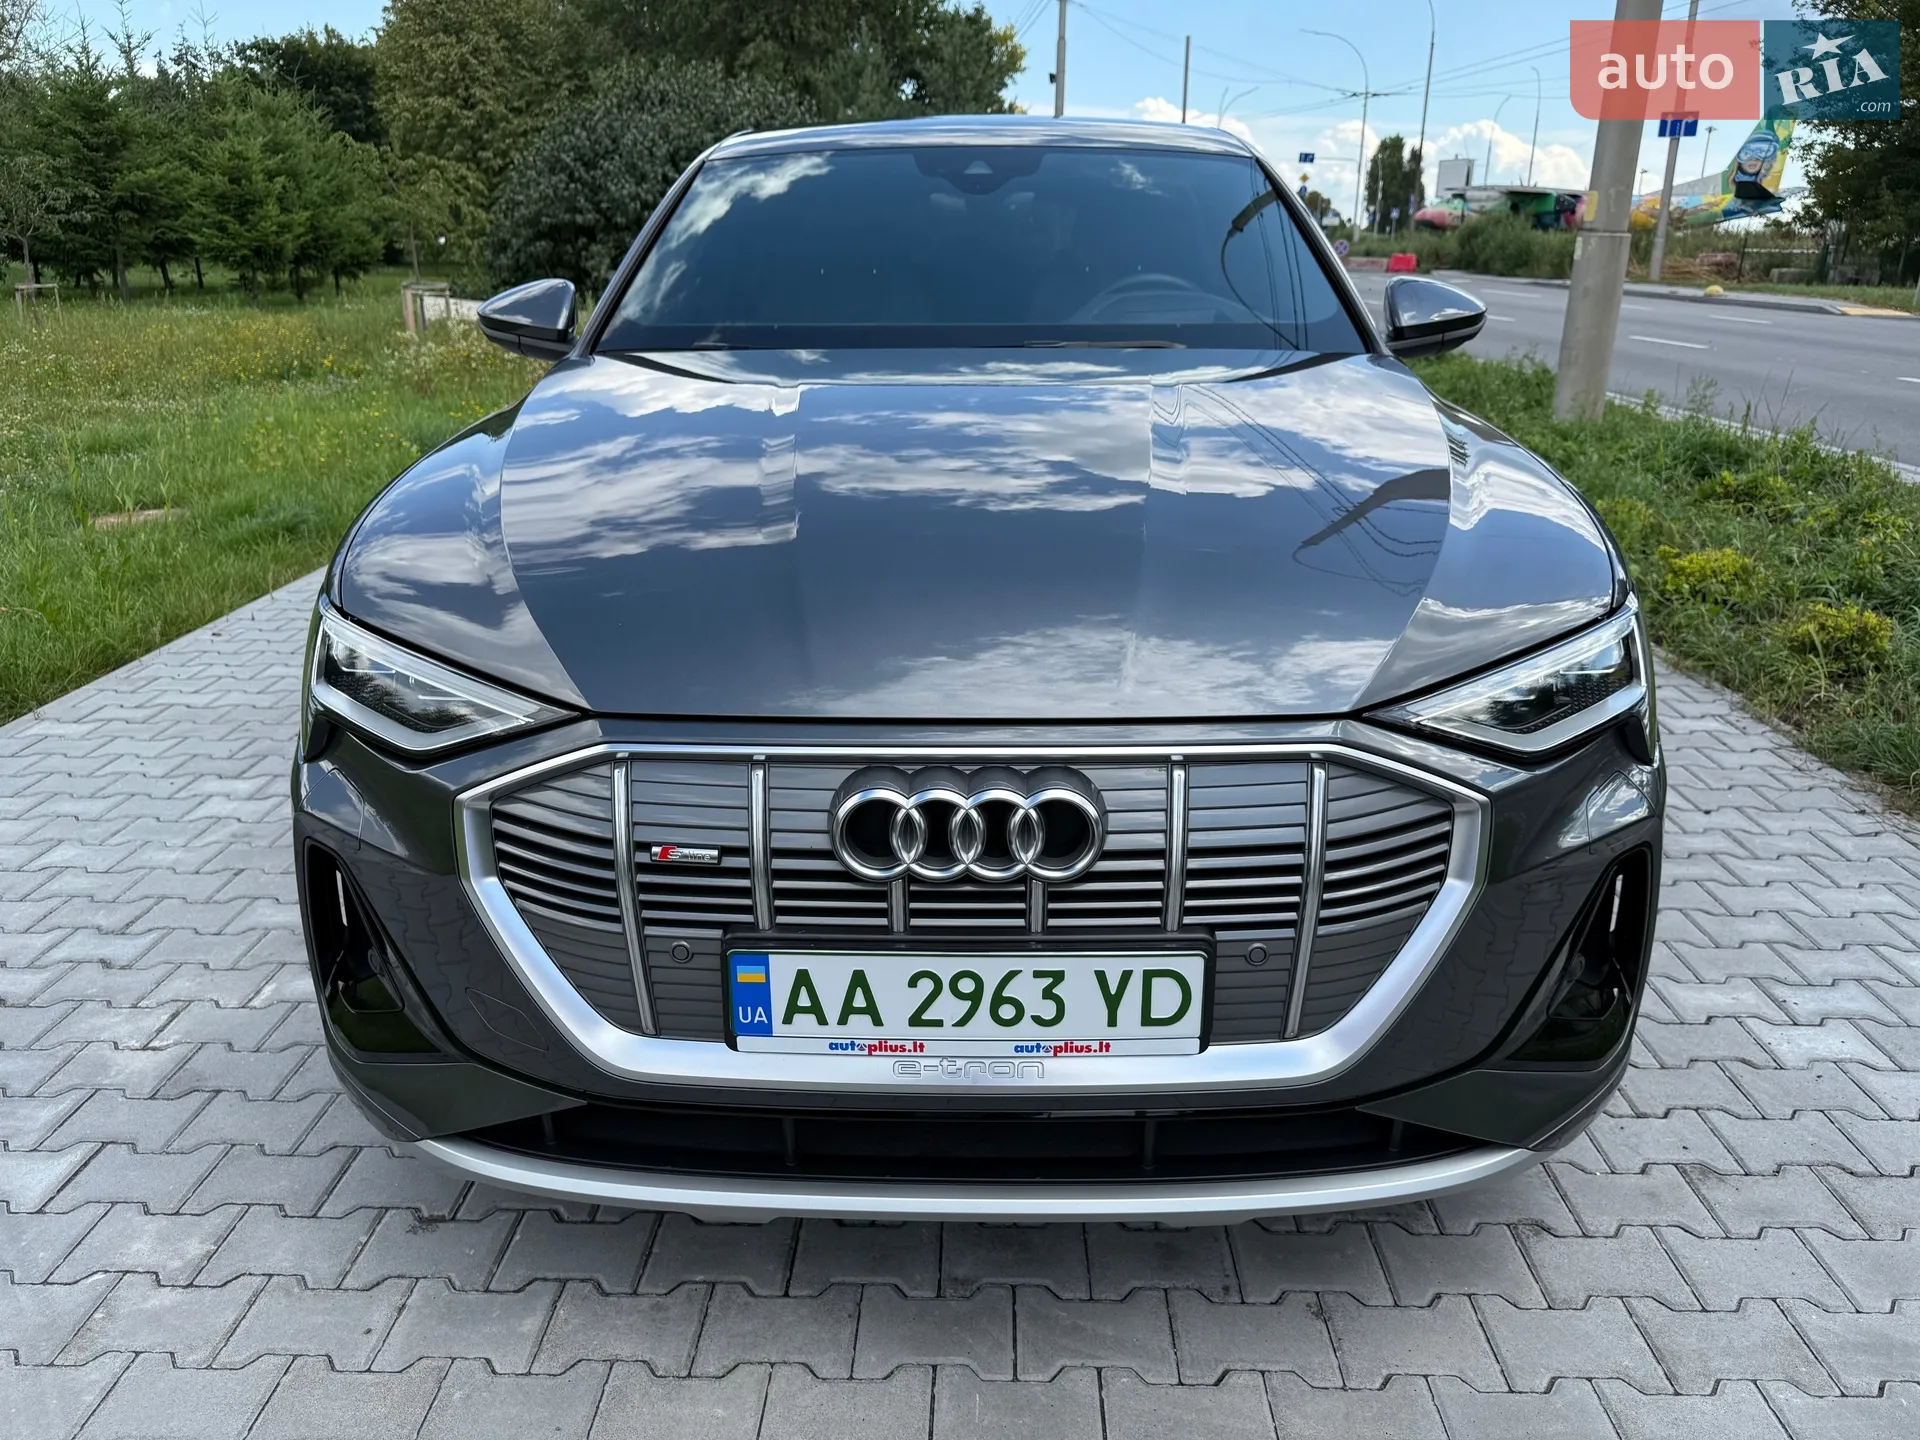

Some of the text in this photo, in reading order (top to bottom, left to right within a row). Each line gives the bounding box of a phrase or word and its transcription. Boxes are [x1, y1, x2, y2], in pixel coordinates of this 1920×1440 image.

[688, 850, 711, 861] line
[781, 968, 1192, 1027] AA 2963 YD
[738, 1006, 768, 1024] UA
[892, 1057, 1045, 1079] e-tron
